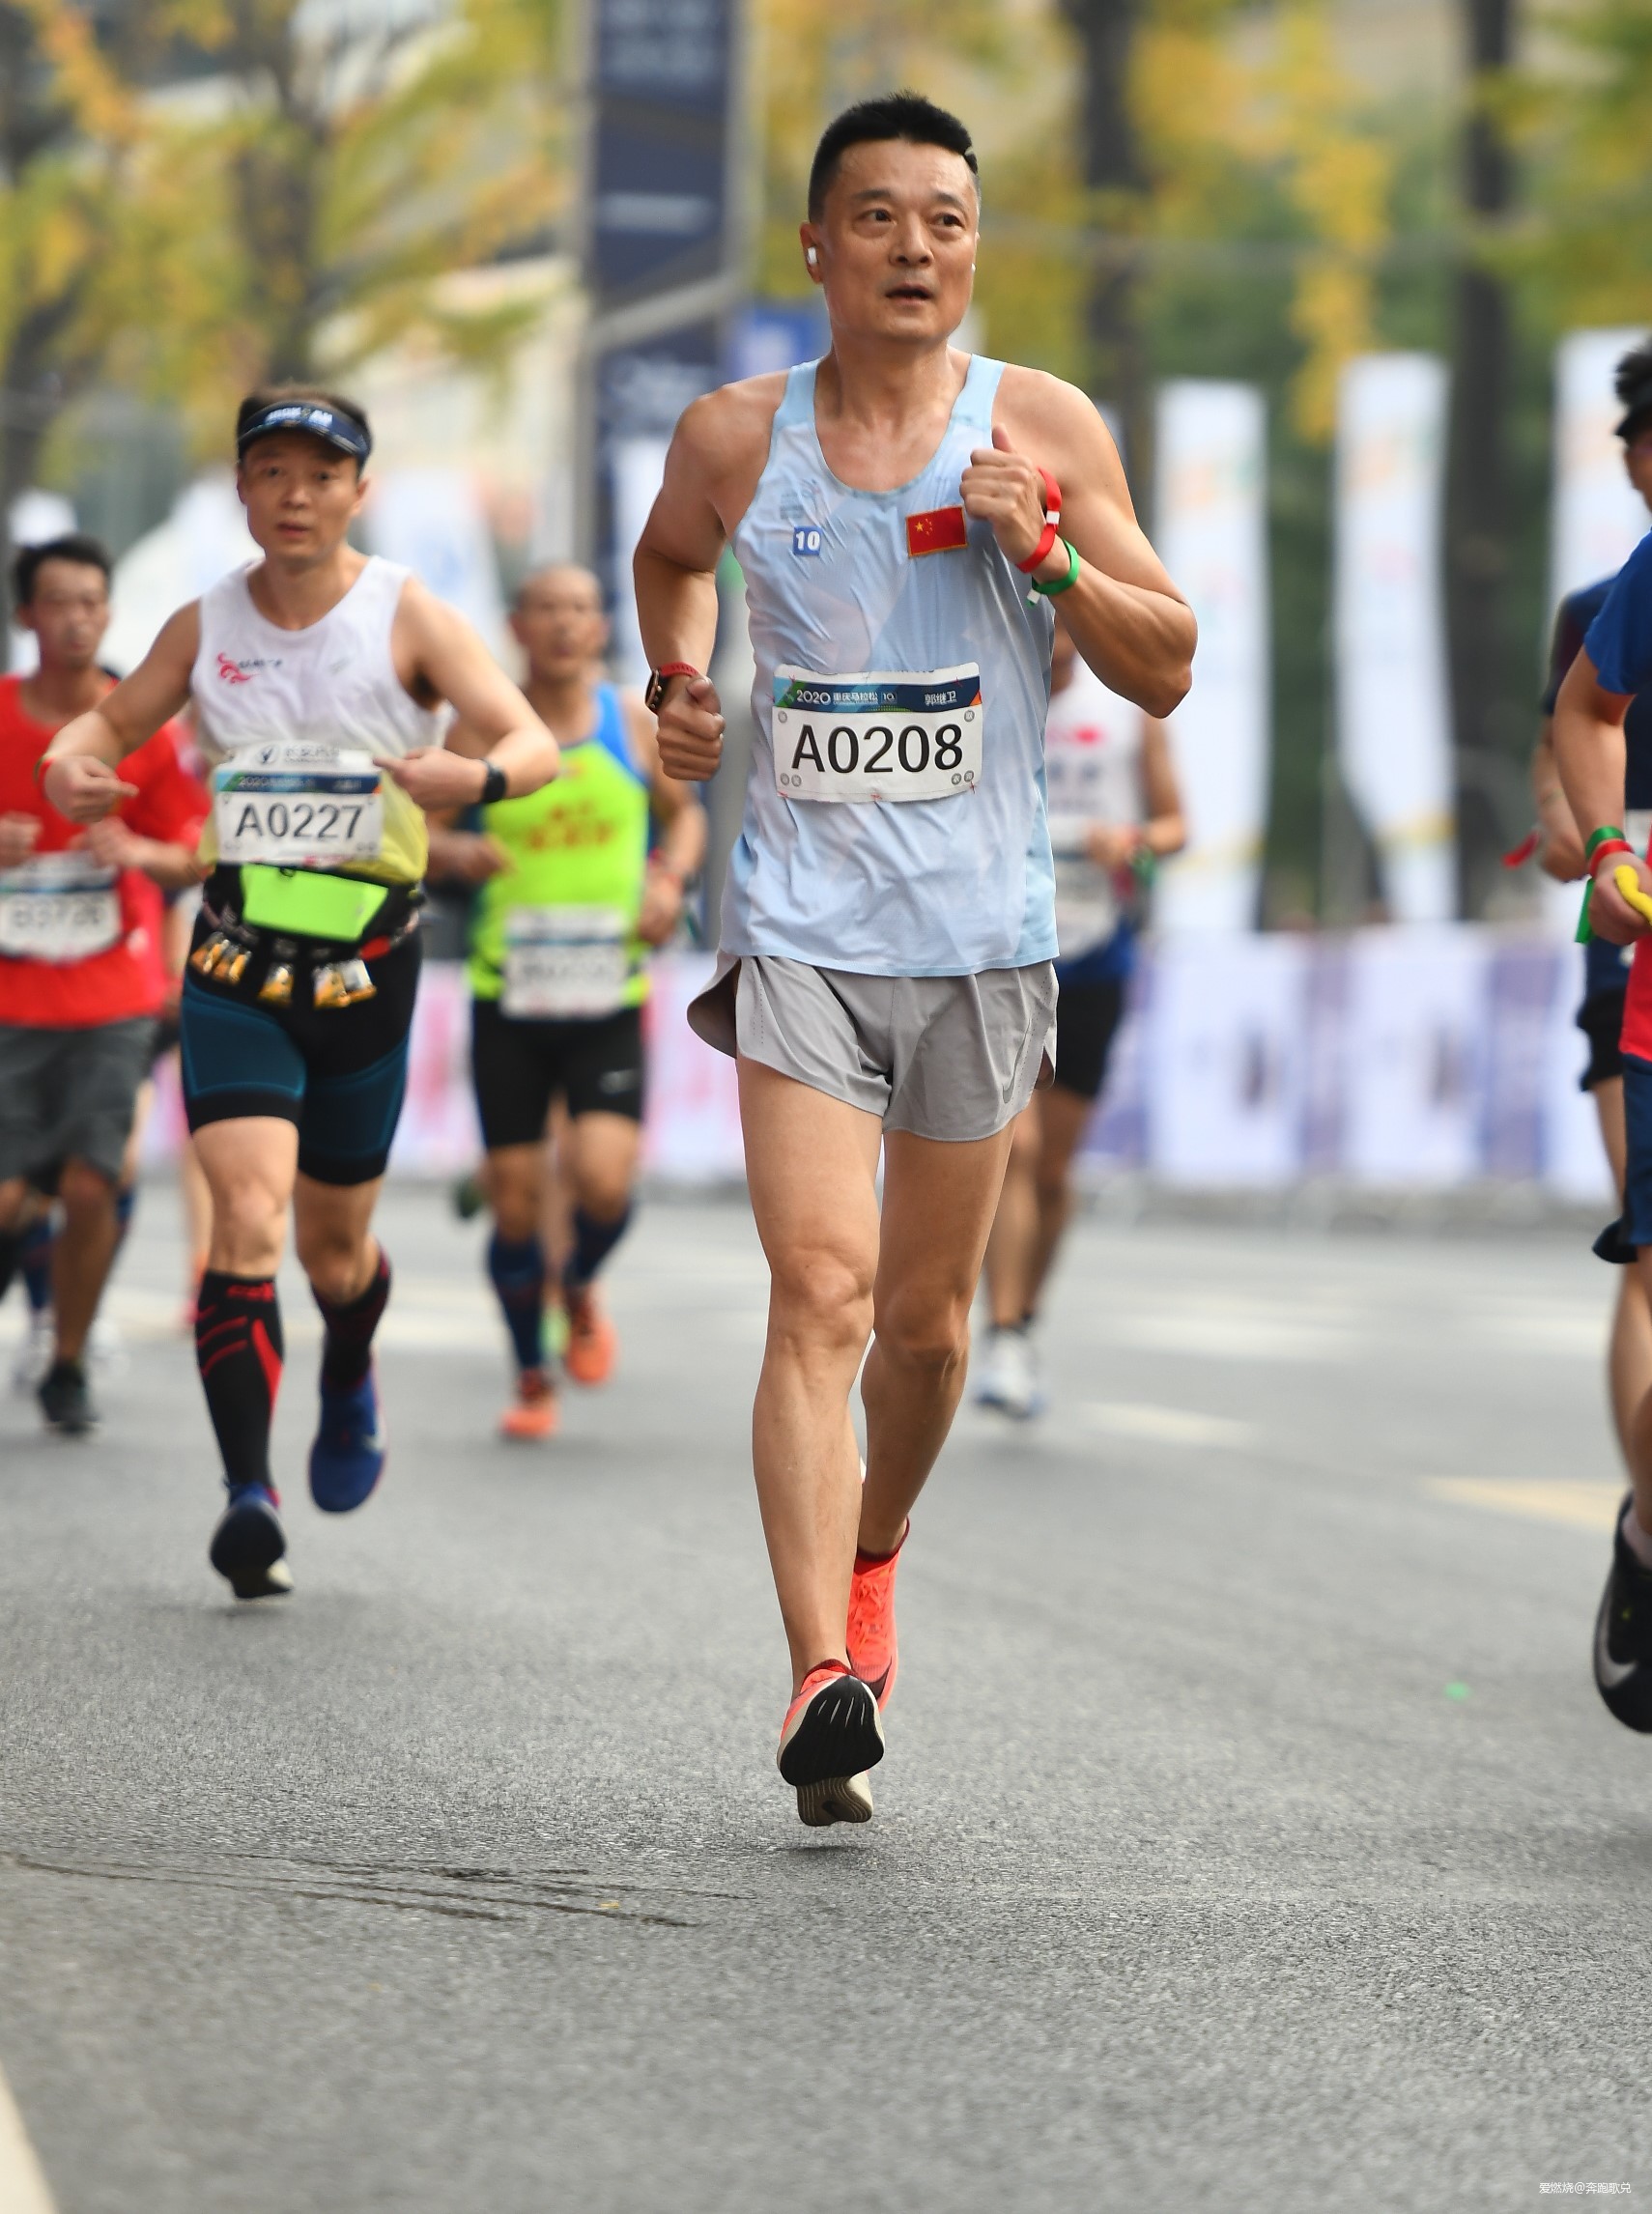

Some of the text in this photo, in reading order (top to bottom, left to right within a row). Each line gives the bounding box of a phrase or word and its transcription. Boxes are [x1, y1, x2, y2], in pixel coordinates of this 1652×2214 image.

[795, 530, 821, 551] 10
[796, 690, 831, 705] 2020
[791, 724, 963, 774] A0208
[236, 802, 363, 839] A0227
